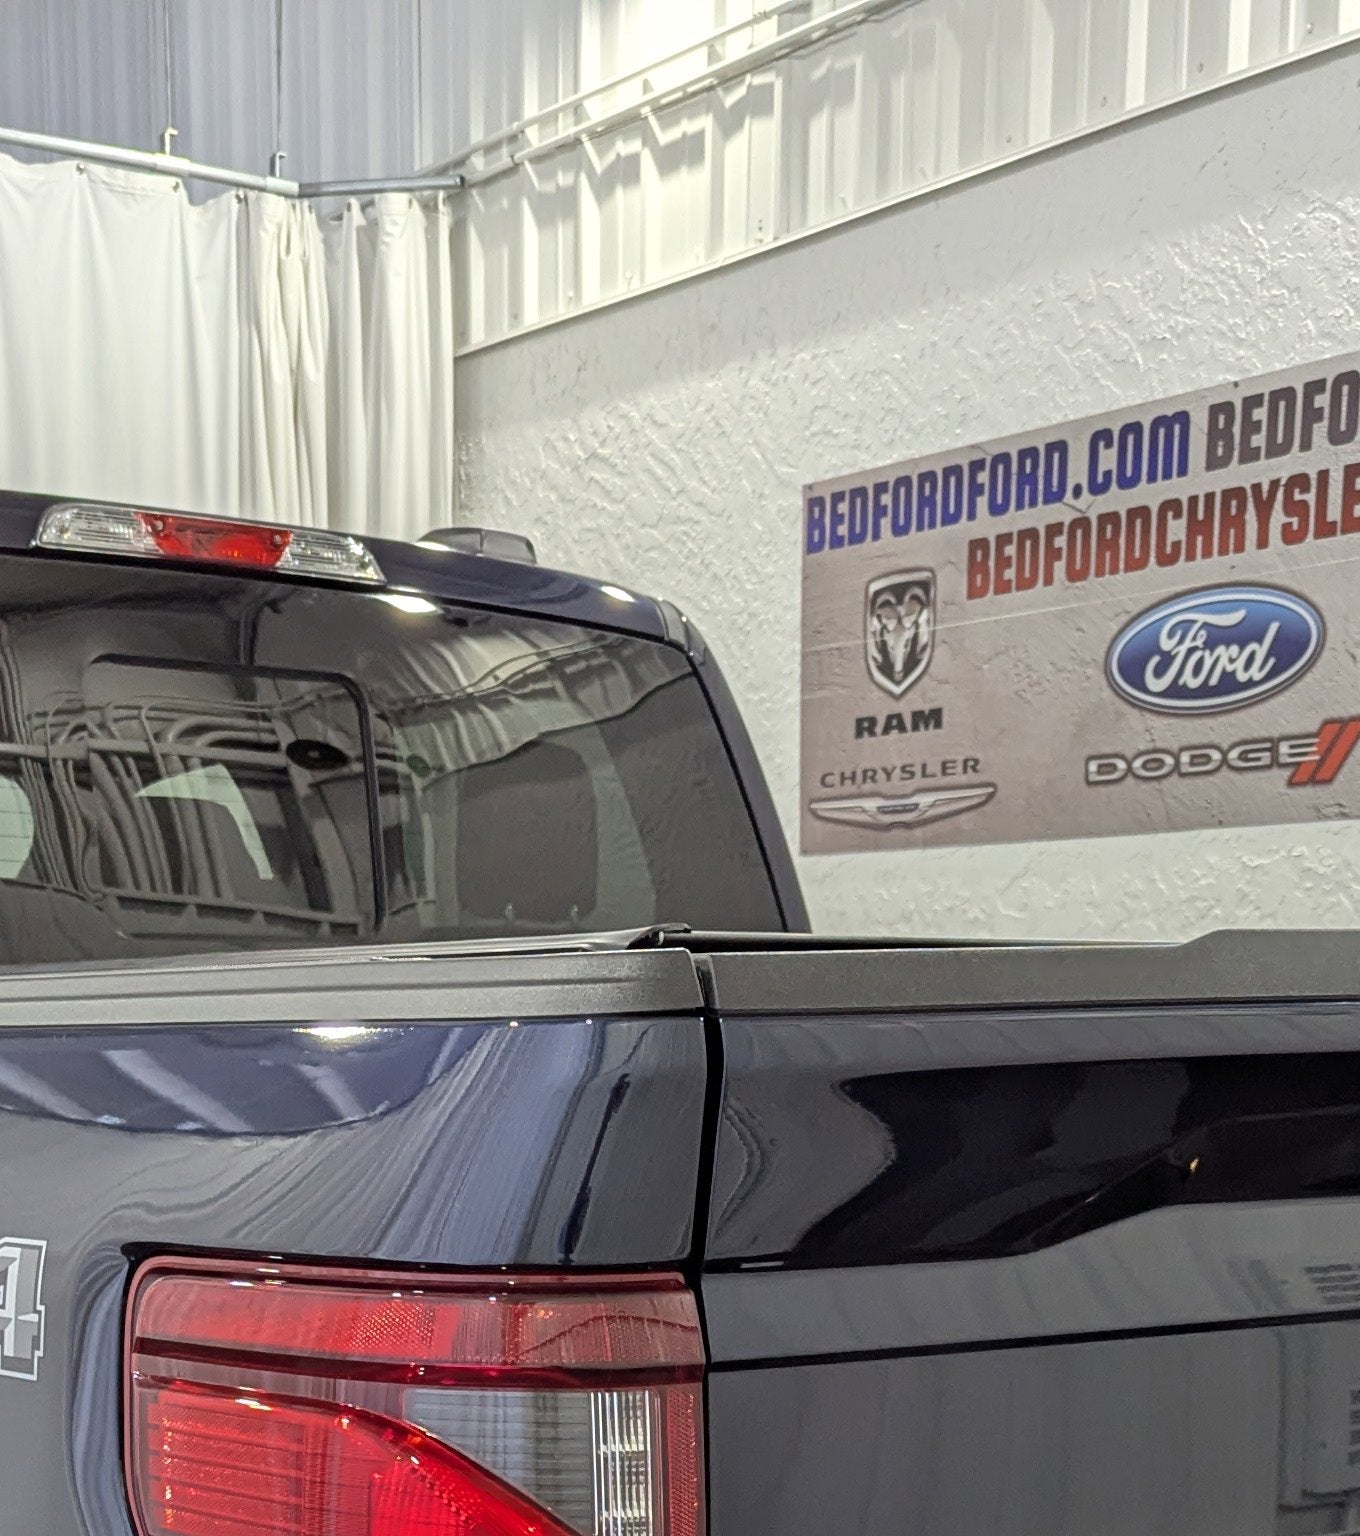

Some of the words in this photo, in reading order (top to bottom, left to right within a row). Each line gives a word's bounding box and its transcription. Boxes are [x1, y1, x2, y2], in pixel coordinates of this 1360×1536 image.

[806, 410, 1190, 554] BEDFORDFORD.COM
[1143, 609, 1277, 692] Ford
[854, 707, 943, 740] RAM
[820, 756, 981, 789] CHRYSLER
[1085, 735, 1320, 785] DODGE
